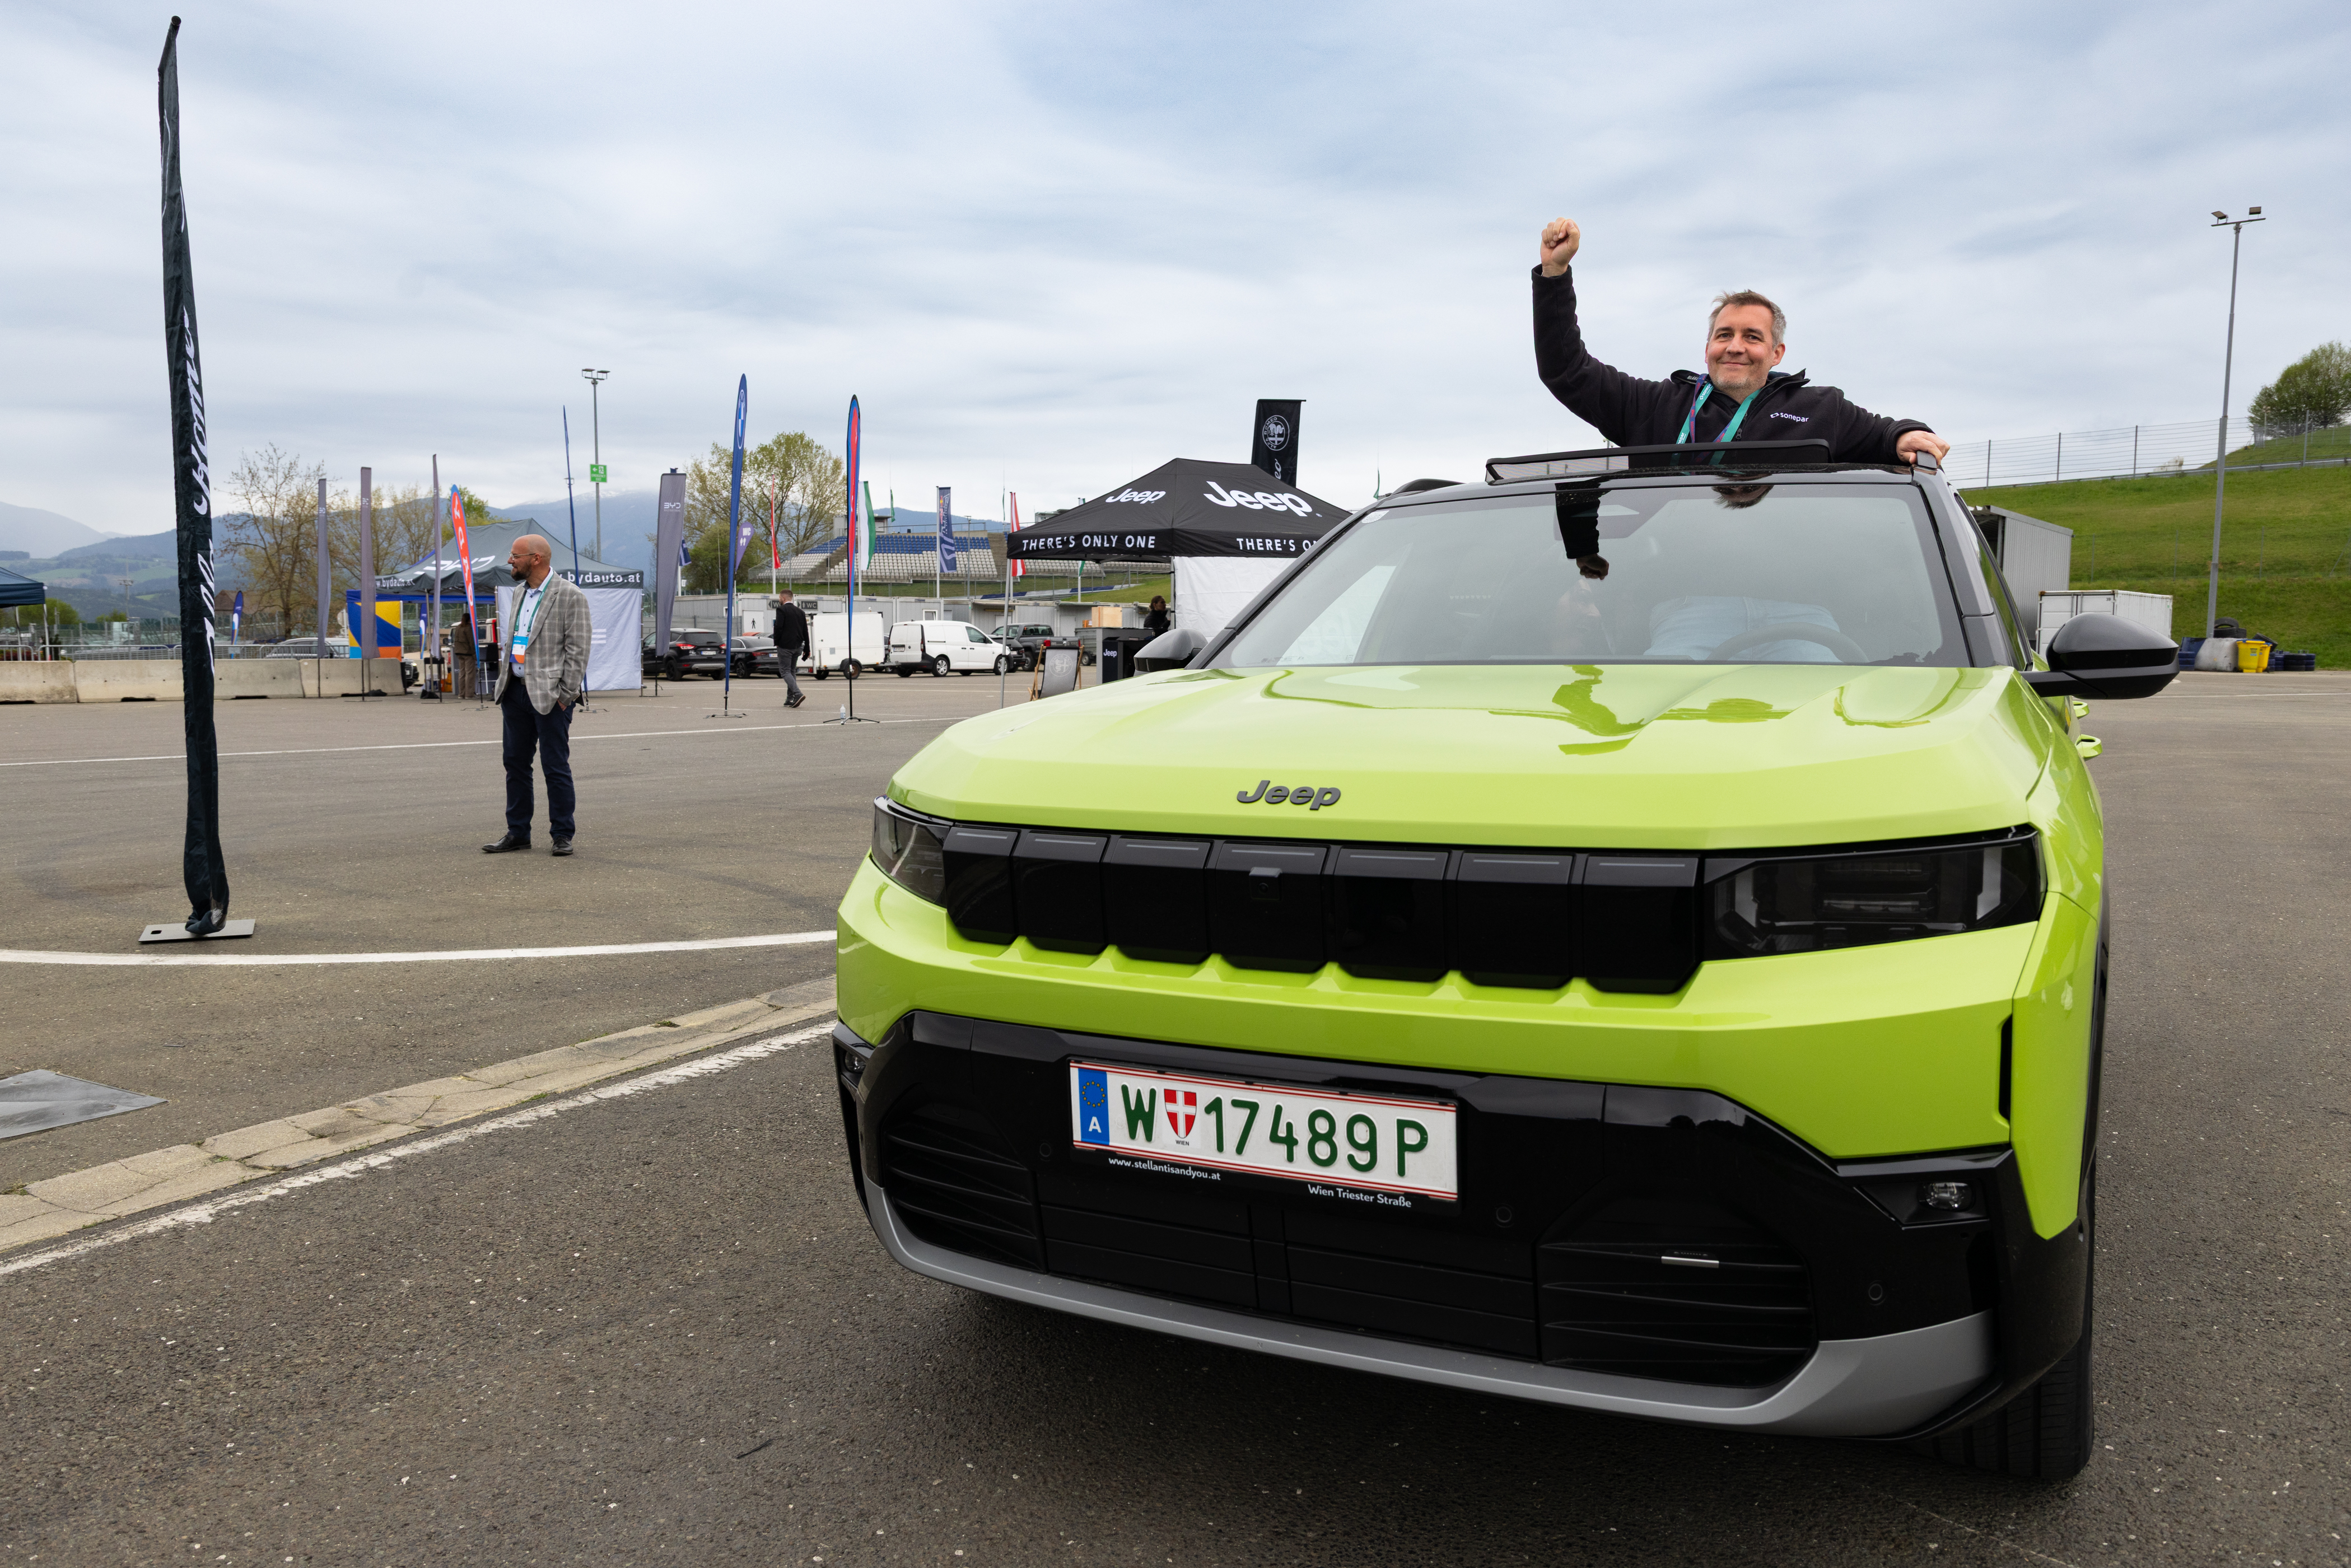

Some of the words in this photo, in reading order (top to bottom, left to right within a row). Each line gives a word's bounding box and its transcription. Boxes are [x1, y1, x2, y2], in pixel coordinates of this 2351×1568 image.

[1780, 412, 1809, 422] sonepar
[1264, 417, 1277, 435] ROMEO
[1264, 437, 1277, 449] ALFA
[1105, 488, 1166, 503] Jeep
[1204, 481, 1312, 516] Jeep
[743, 528, 751, 536] WC
[1022, 536, 1075, 551] THERE'S
[1082, 535, 1118, 547] ONLY
[1125, 535, 1155, 548] ONE
[1236, 538, 1296, 552] THERE'S
[1103, 649, 1117, 658] Jeep
[1237, 780, 1341, 810] Jeep
[1121, 1084, 1157, 1142] W
[1088, 1117, 1102, 1133] A
[1108, 1157, 1221, 1181] www.stellantisandyou.at
[1308, 1184, 1334, 1197] Wien
[1336, 1187, 1374, 1202] Triester
[1377, 1192, 1412, 1208] Straße
